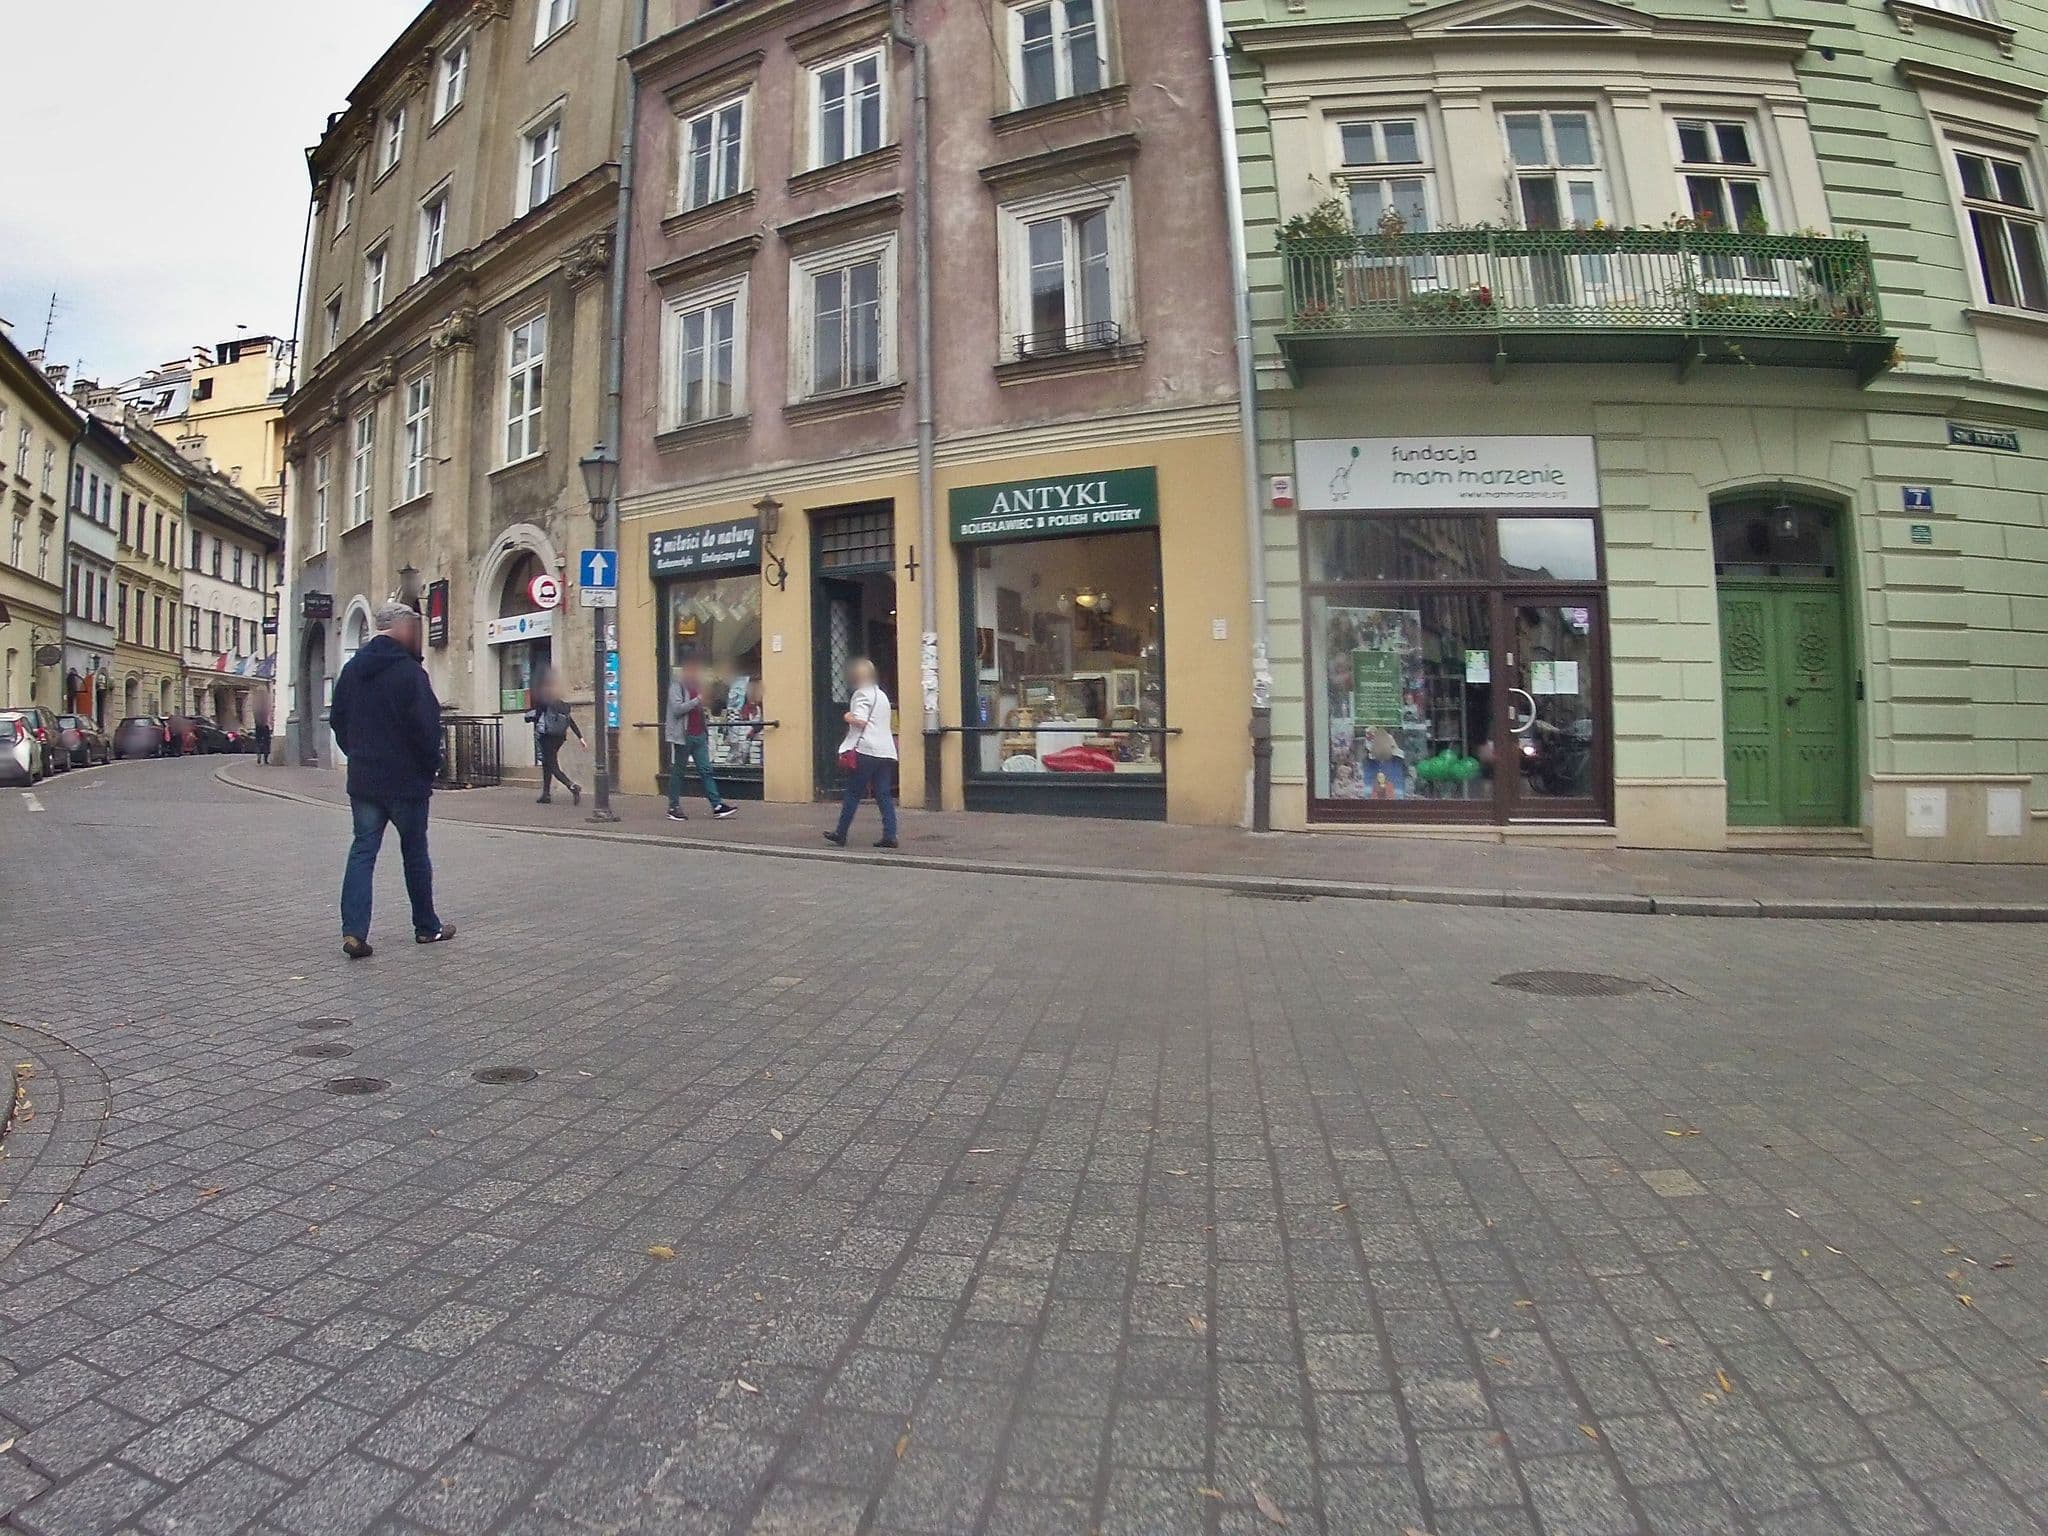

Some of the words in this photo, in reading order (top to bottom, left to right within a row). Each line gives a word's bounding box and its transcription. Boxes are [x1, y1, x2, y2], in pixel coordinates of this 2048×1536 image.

[1392, 445, 1477, 464] fundacja
[1392, 470, 1453, 486] mam
[1458, 464, 1566, 486] marzenie
[990, 481, 1108, 514] ANTYKI
[1048, 512, 1088, 528] POLISH
[1092, 508, 1142, 524] POTTERY
[701, 529, 716, 548] do
[717, 525, 755, 546] natury
